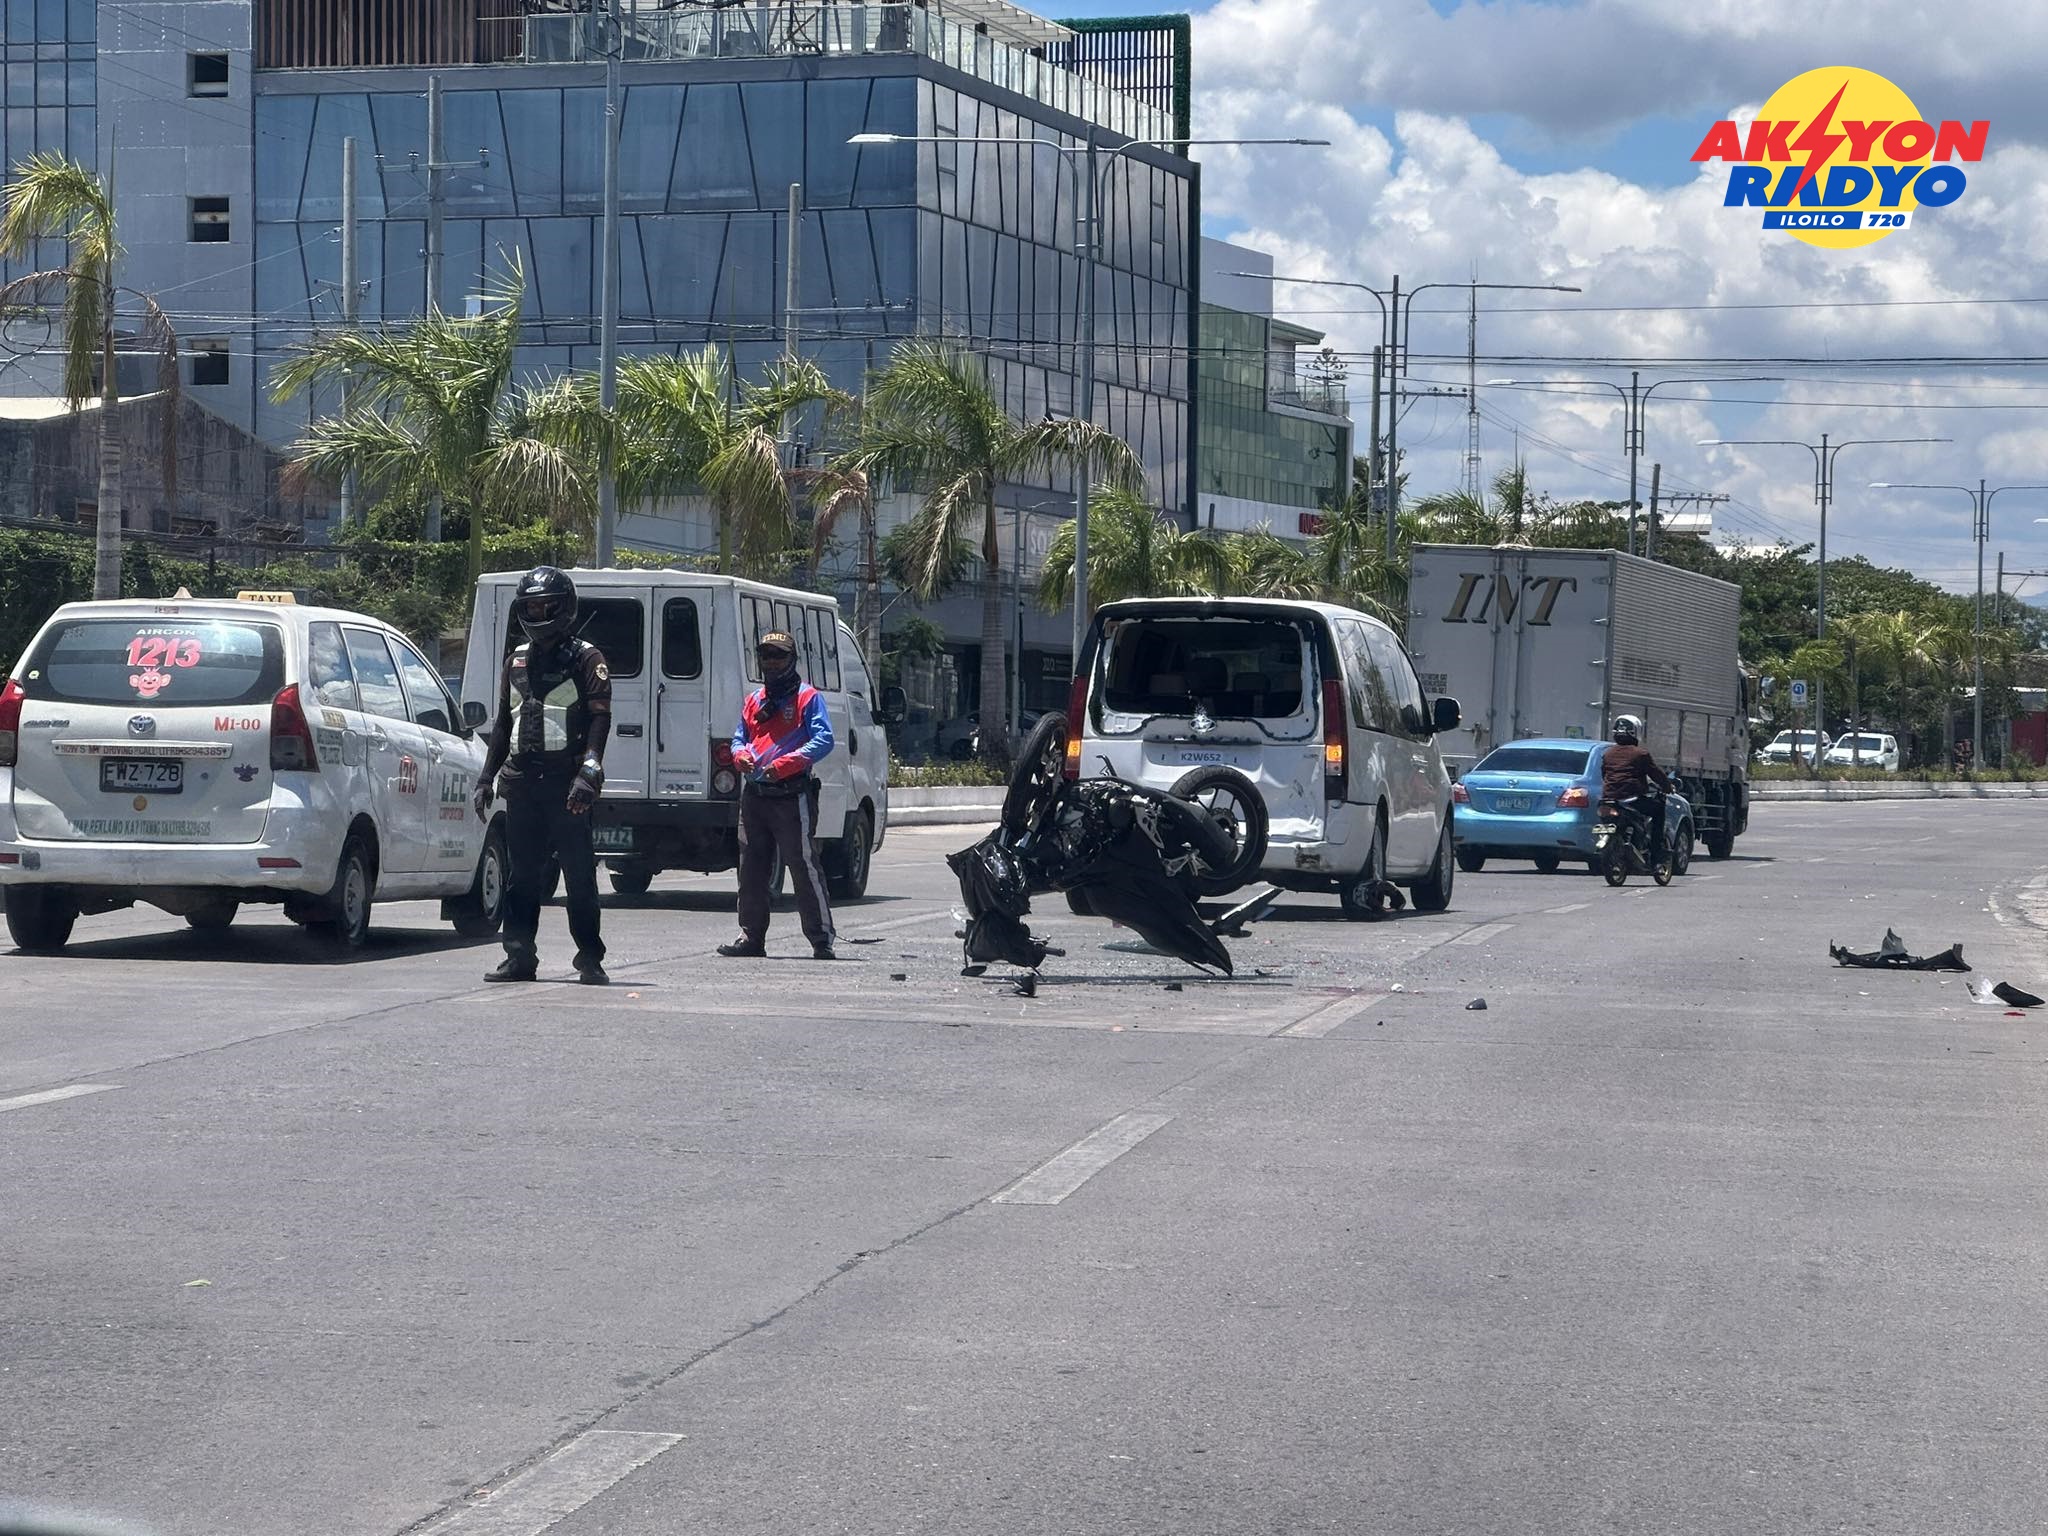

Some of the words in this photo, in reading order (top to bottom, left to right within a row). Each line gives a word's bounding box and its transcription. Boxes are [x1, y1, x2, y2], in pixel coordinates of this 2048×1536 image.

[249, 594, 282, 603] TAXI
[1441, 573, 1578, 627] INT
[135, 628, 197, 636] AIRCON
[125, 636, 202, 669] 1213
[1180, 752, 1222, 762] K2W652
[144, 764, 180, 782] 728
[398, 757, 418, 795] 1213
